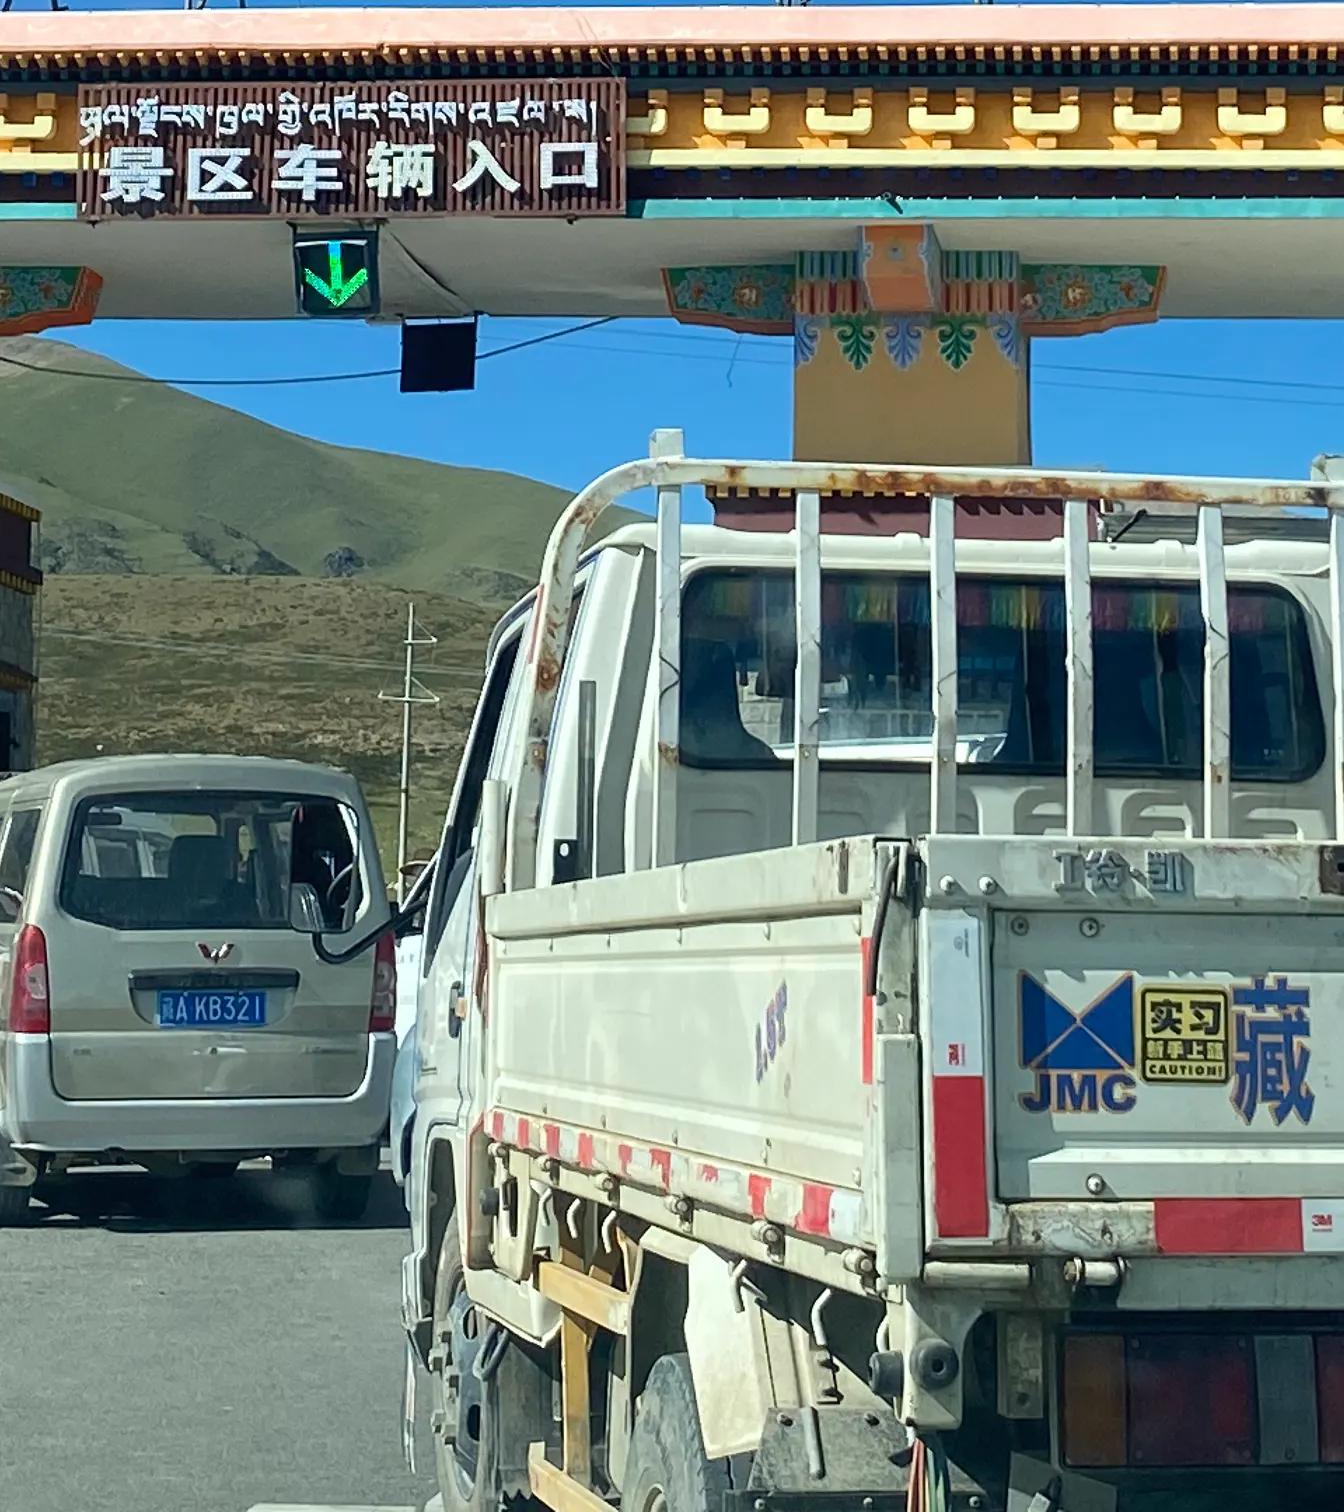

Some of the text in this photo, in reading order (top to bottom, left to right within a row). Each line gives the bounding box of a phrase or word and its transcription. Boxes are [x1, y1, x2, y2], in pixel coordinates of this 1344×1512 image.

[98, 139, 600, 202] 景区车辆入口
[1150, 998, 1224, 1036] 实习
[1148, 1063, 1223, 1077] CAUTION!
[1019, 1072, 1138, 1114] JMC
